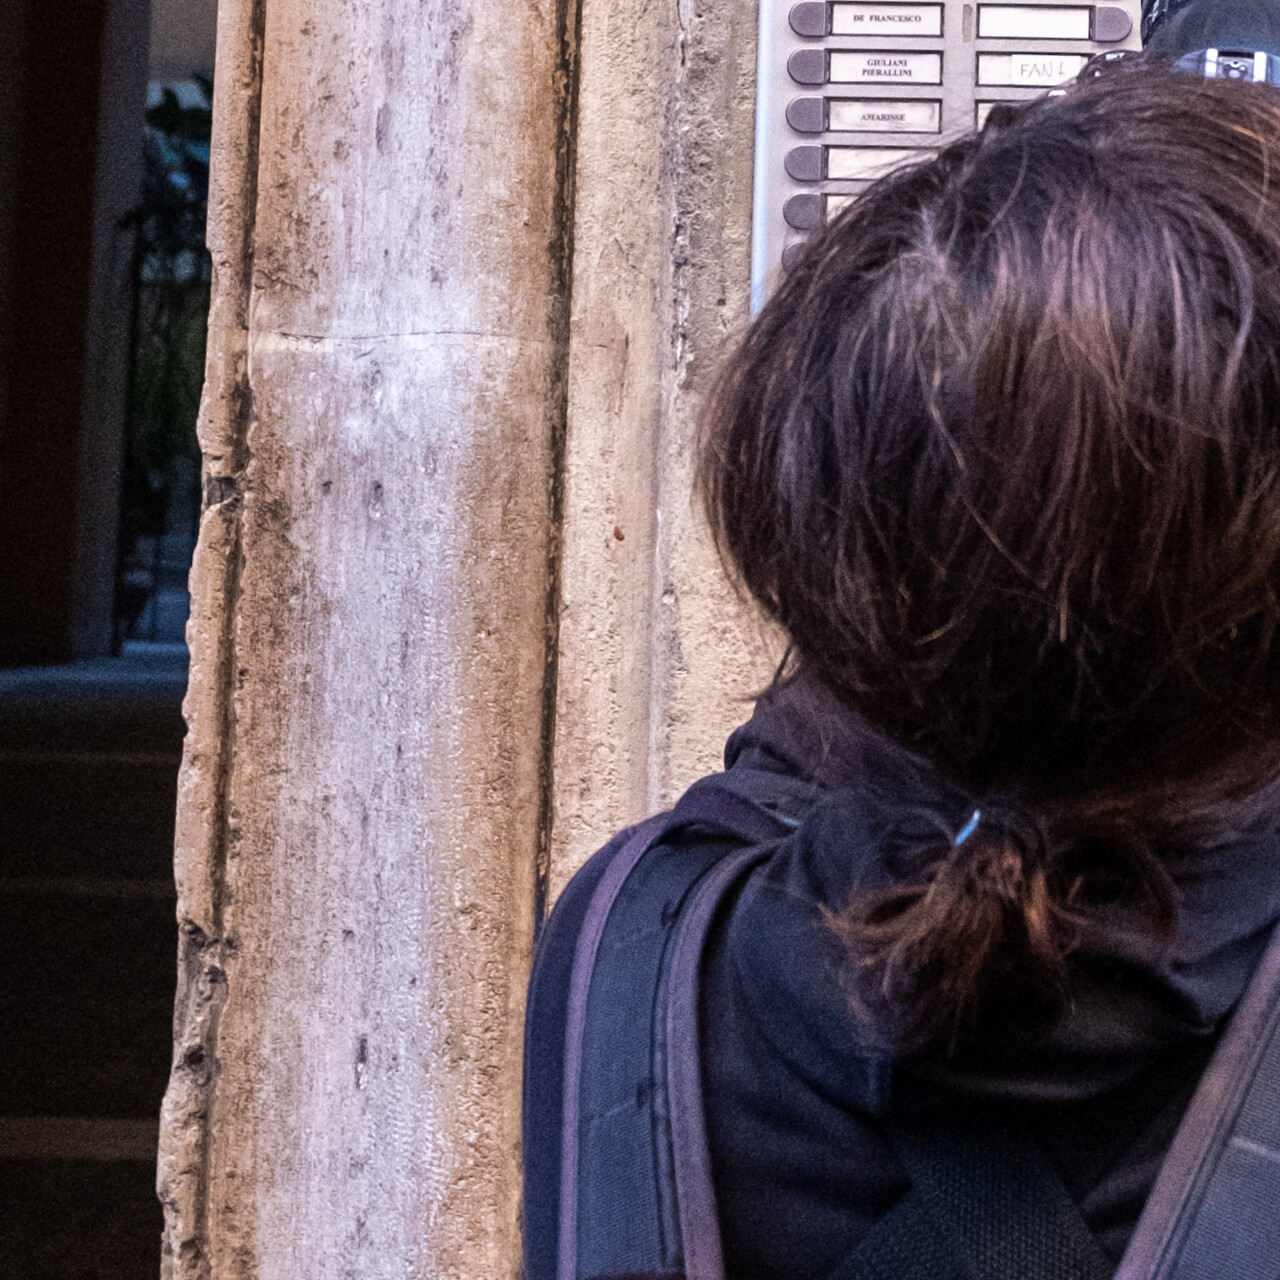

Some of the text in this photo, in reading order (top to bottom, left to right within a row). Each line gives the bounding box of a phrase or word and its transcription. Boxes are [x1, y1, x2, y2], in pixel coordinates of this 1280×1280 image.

[869, 15, 922, 23] FRANCESCO
[867, 59, 907, 67] GIULIANI
[862, 69, 912, 77] PIERALLINI
